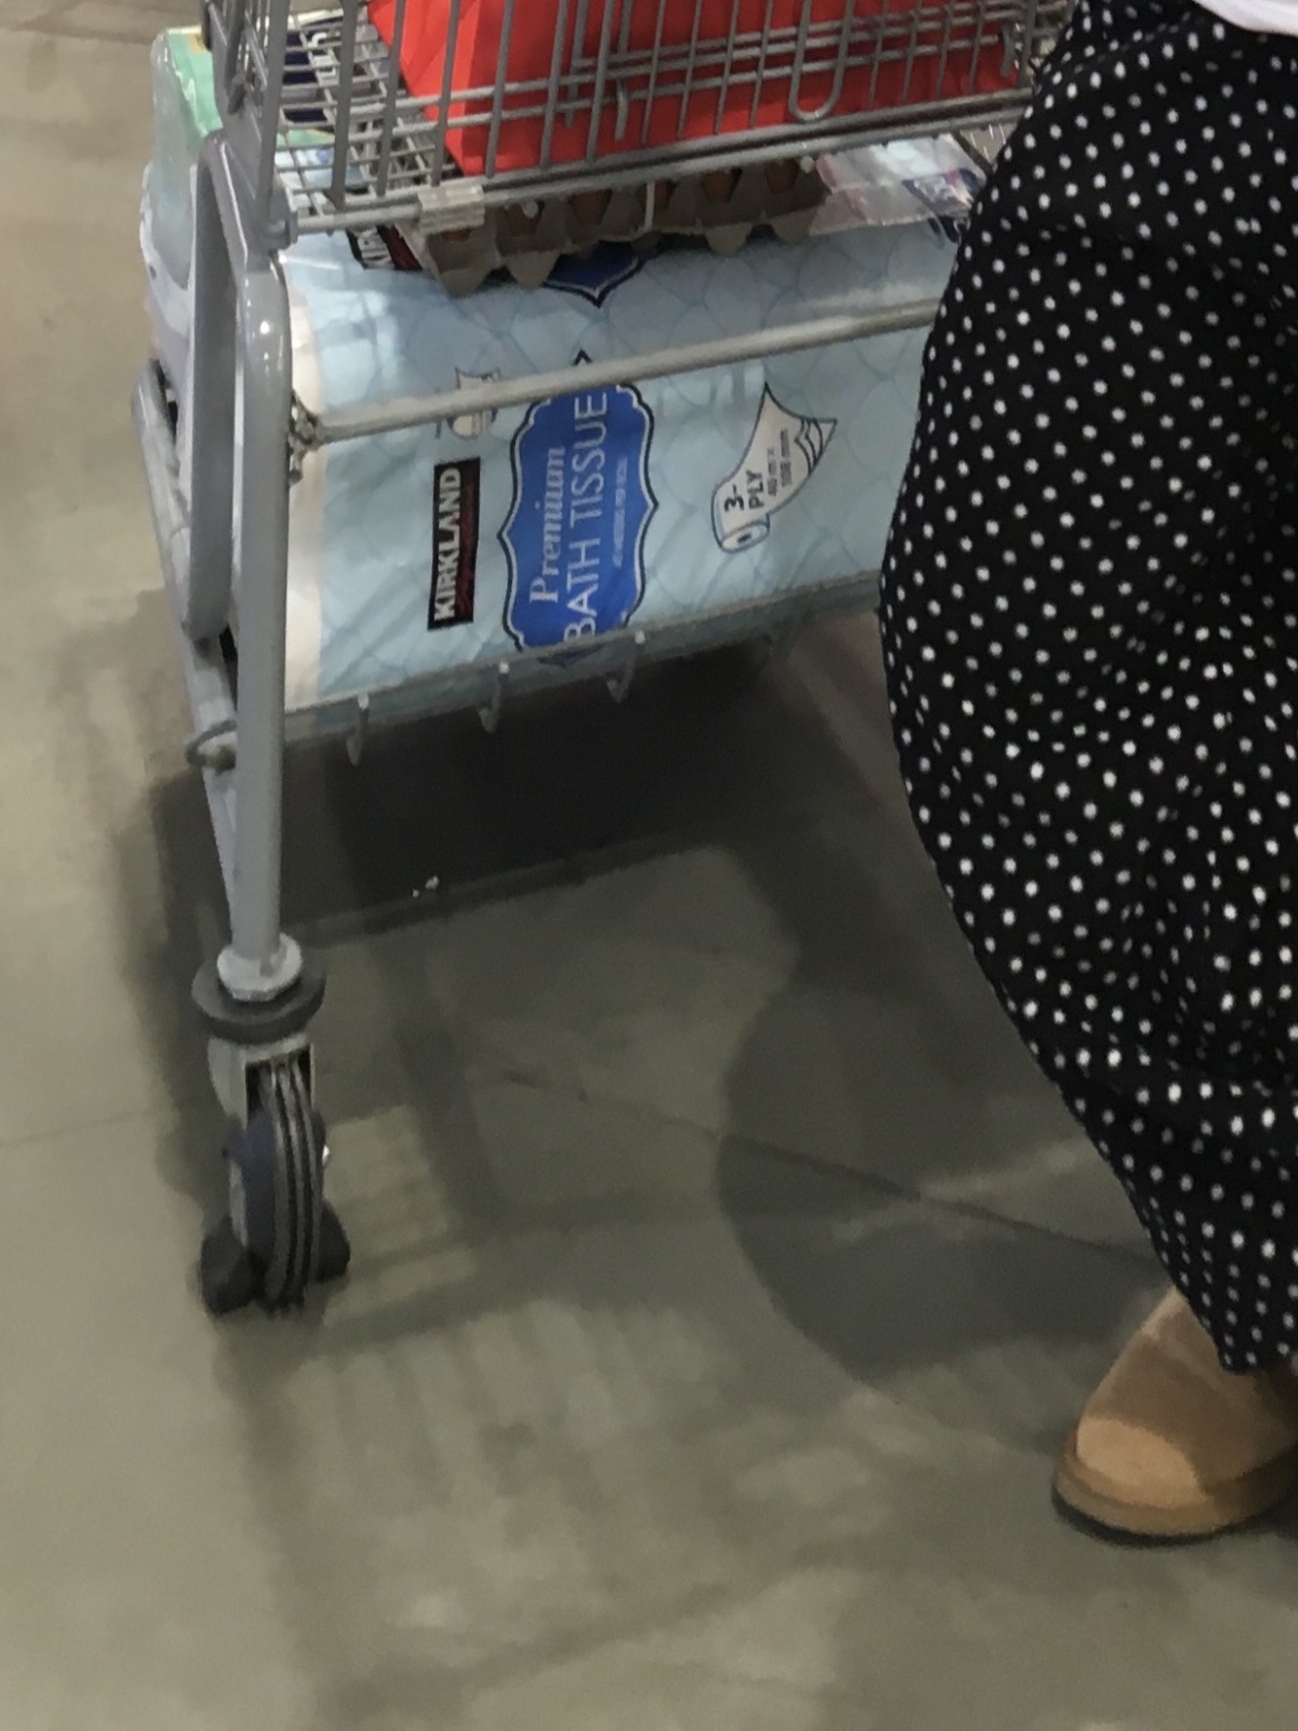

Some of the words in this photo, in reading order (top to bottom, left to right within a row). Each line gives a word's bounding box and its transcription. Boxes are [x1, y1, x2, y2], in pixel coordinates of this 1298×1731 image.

[529, 444, 566, 604] Premium
[569, 392, 608, 529] TISSUE
[745, 469, 765, 510] PLY
[433, 467, 461, 621] KIRKLAND
[563, 537, 600, 638] BATH
